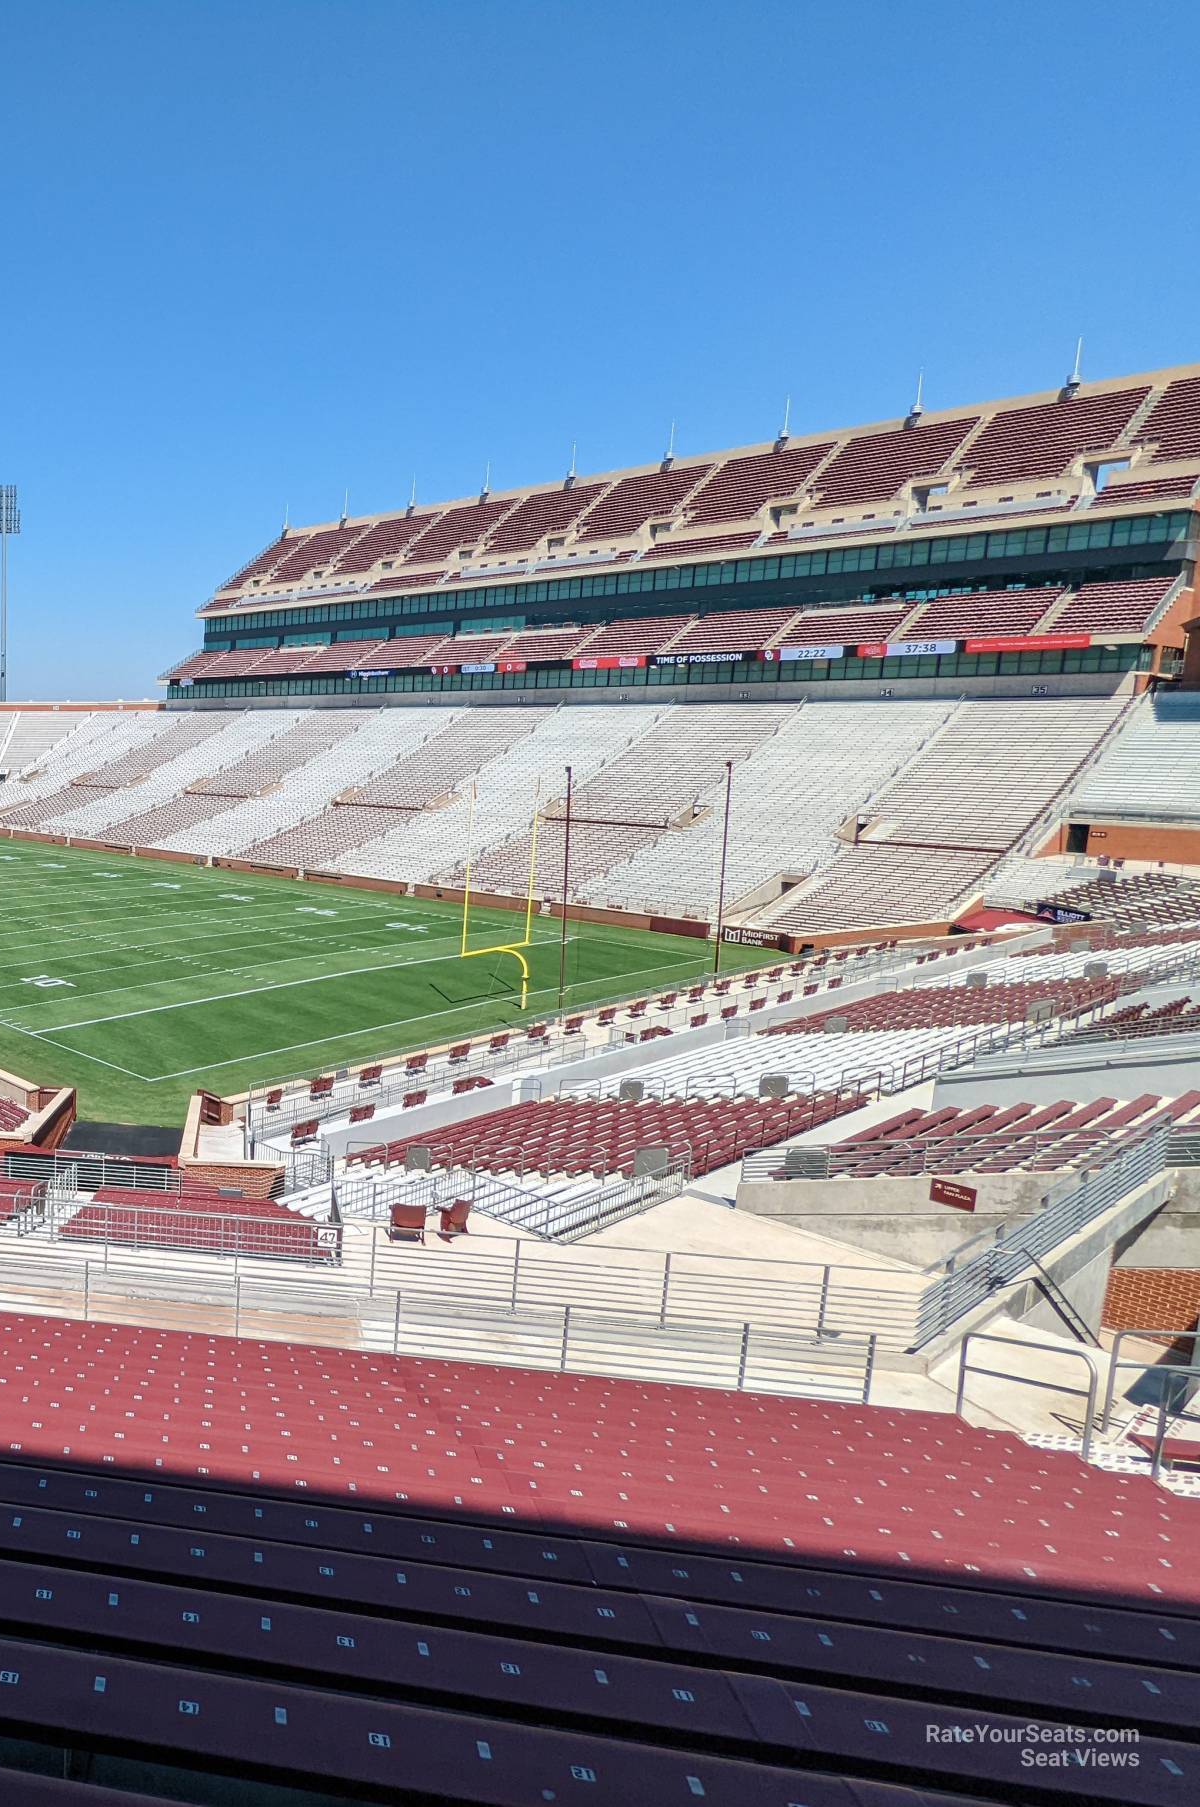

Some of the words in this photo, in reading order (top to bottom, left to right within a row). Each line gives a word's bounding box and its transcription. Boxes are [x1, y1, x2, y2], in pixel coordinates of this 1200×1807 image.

[798, 649, 826, 658] 22:22
[905, 644, 937, 653] 37:38
[656, 656, 675, 665] TIME
[676, 655, 688, 663] OF
[689, 653, 742, 663] POSSESSION
[1033, 686, 1047, 694] 35
[1057, 909, 1085, 920] ELLIOTT
[20, 975, 68, 987] 10
[320, 1232, 336, 1243] 47
[502, 1664, 519, 1673] 12
[0, 1672, 18, 1683] 15
[180, 1702, 198, 1713] 14
[370, 1734, 389, 1747] 13
[572, 1767, 595, 1781] 12
